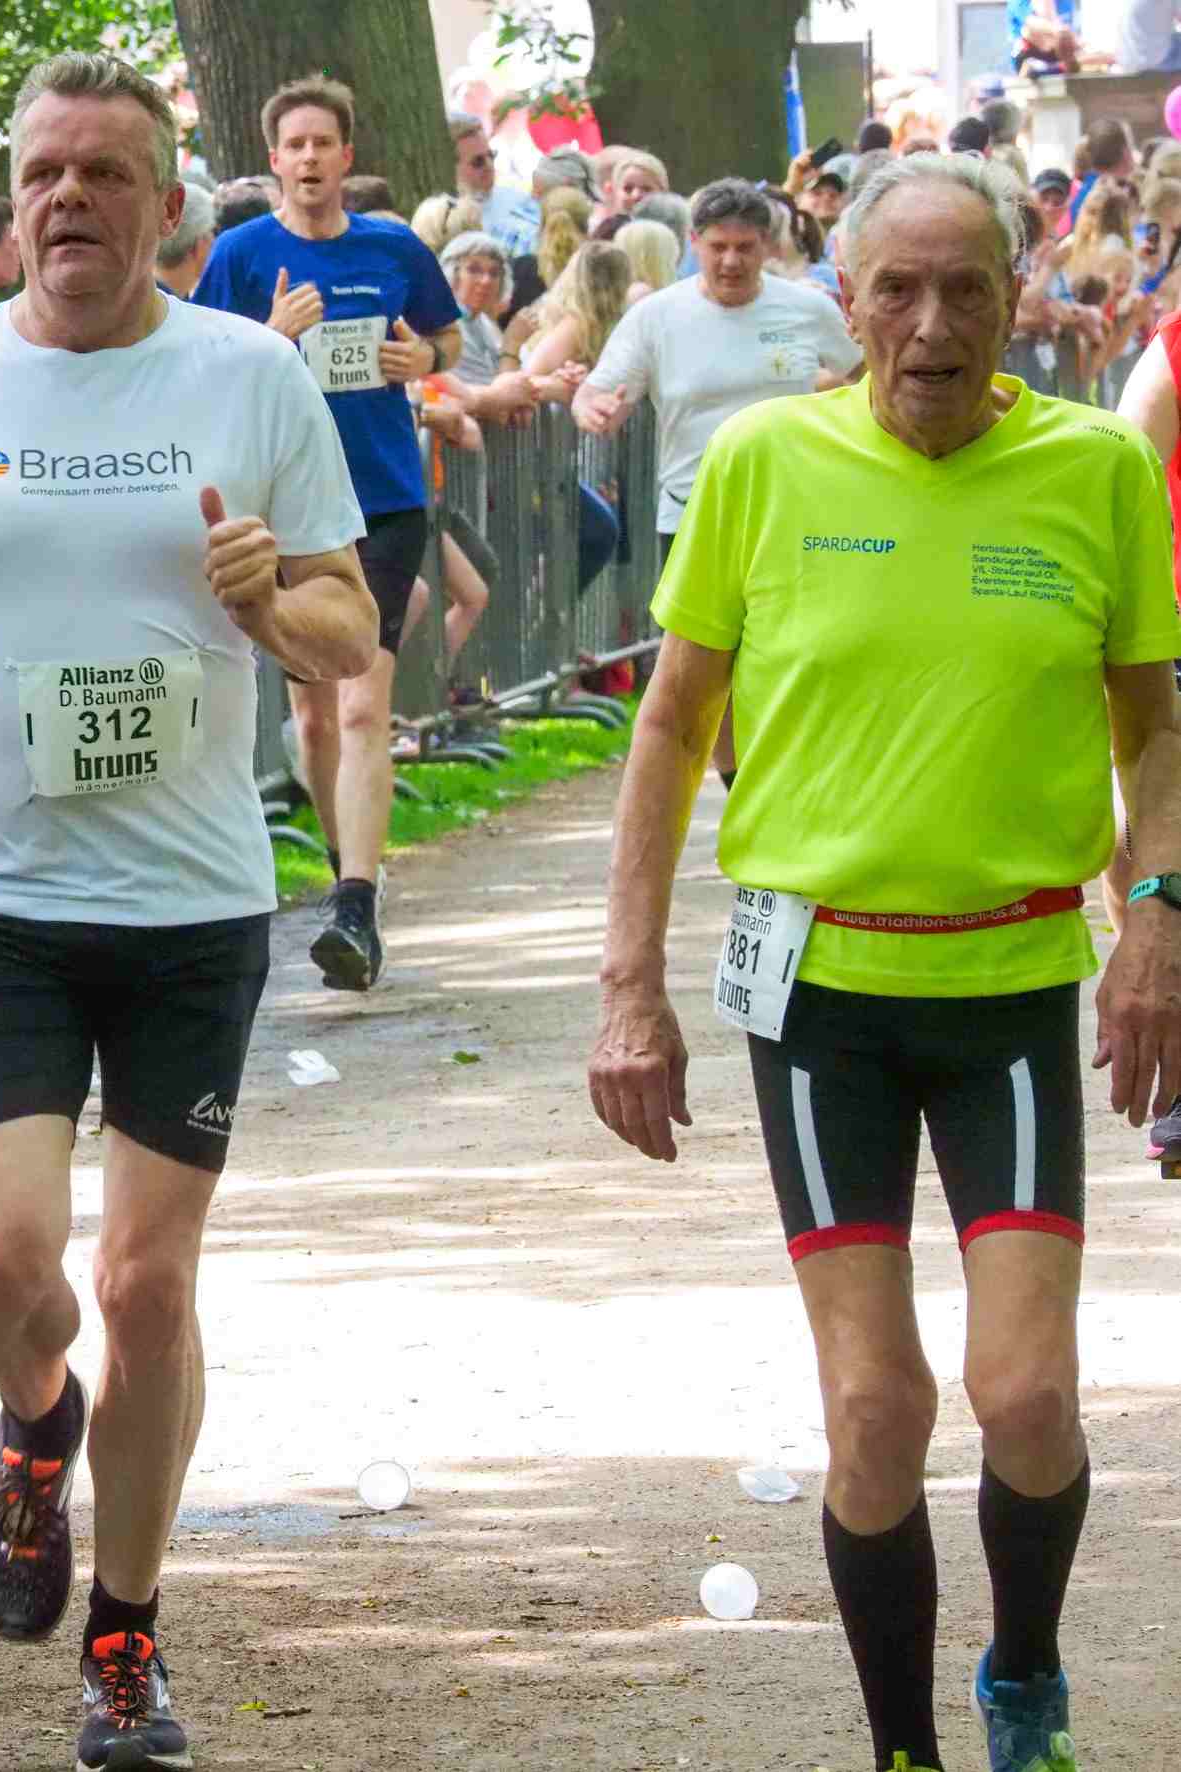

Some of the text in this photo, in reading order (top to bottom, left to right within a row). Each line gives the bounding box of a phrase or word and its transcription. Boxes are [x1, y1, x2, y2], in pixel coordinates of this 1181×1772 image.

[331, 345, 367, 366] 625
[329, 368, 371, 385] bruns
[20, 443, 193, 480] Braasch
[21, 486, 90, 498] Gemeinsam
[93, 485, 124, 496] mehr
[802, 536, 896, 553] SPARDACUP
[59, 667, 135, 687] Allianz
[59, 685, 168, 707] D. Baumann
[78, 706, 153, 744] 312
[73, 748, 158, 782] bruns
